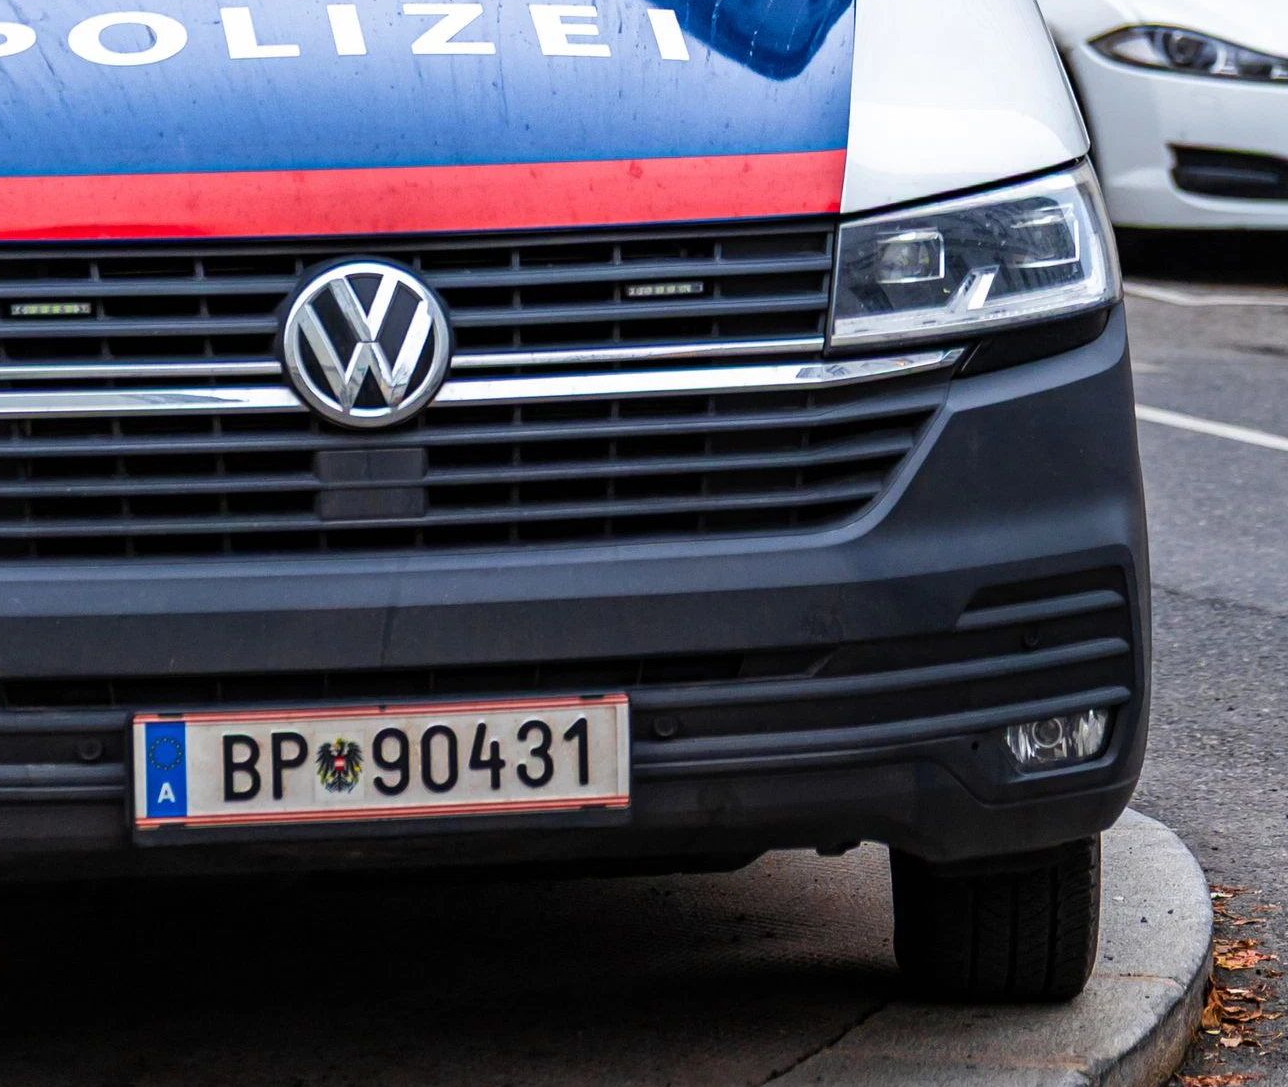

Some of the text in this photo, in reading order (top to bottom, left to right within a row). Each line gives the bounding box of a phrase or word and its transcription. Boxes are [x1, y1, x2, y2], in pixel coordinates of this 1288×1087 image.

[222, 716, 590, 803] BP 90431
[157, 782, 176, 804] A
